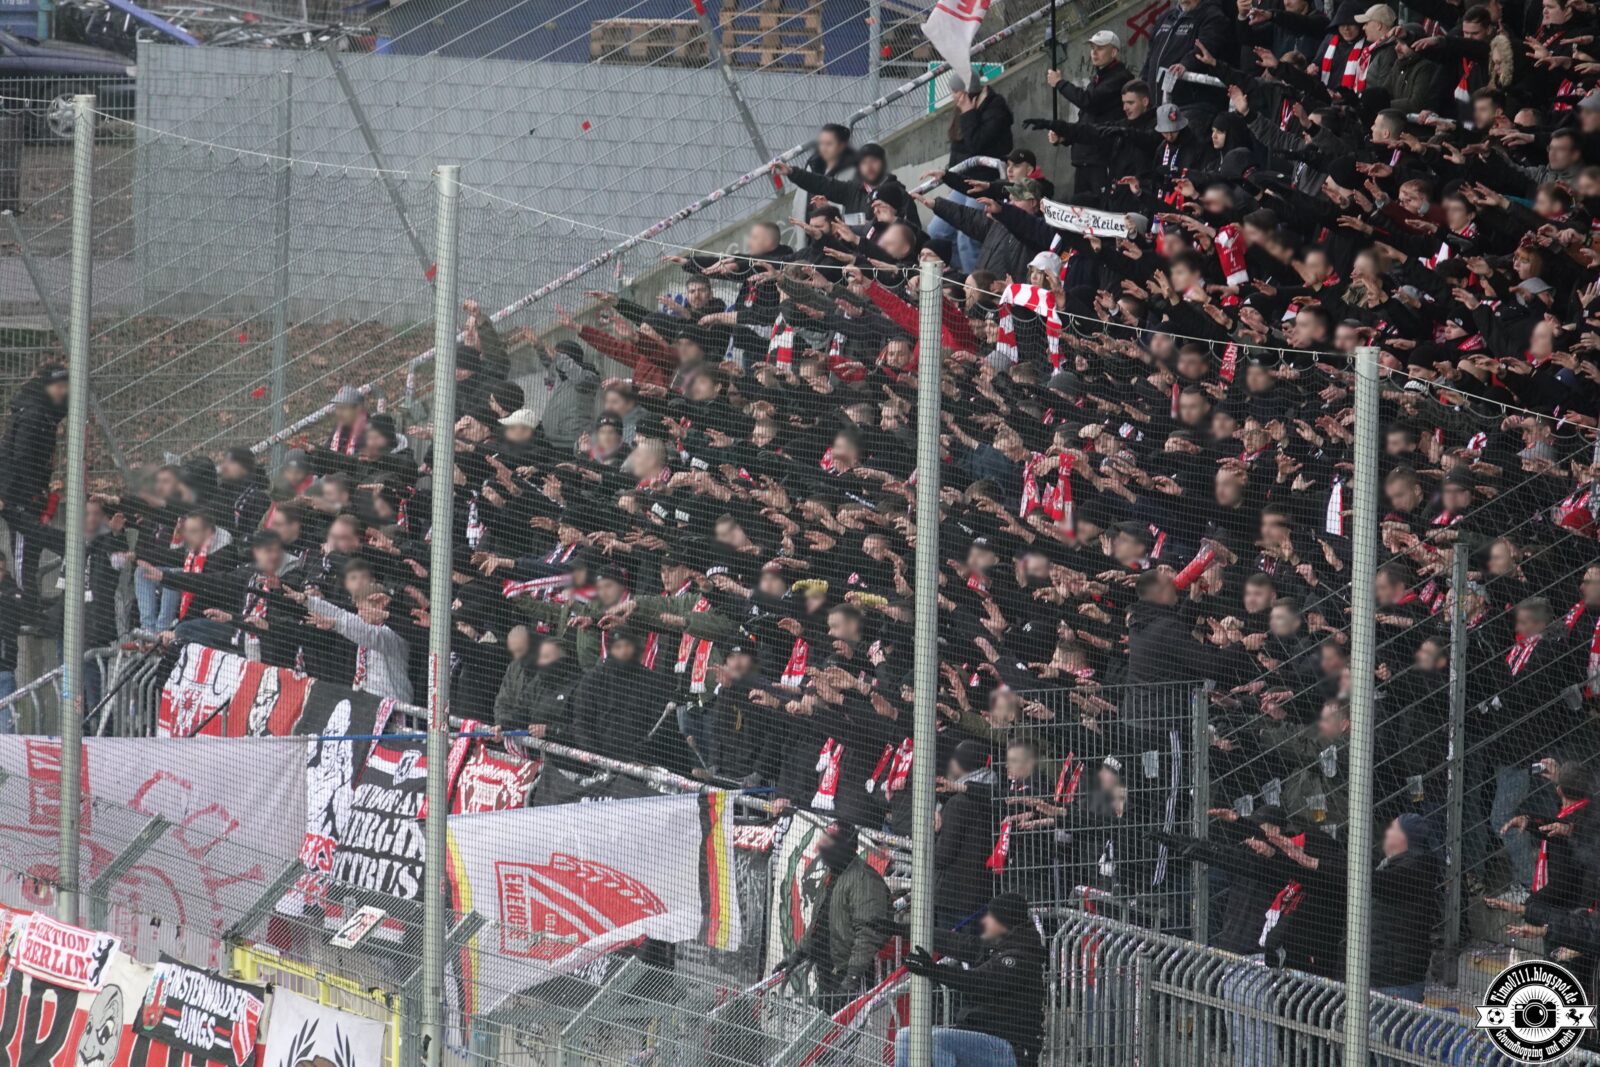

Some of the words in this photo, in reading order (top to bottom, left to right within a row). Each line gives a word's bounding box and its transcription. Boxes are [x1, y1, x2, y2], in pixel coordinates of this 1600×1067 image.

[22, 939, 93, 980] BERLIN
[164, 963, 249, 1022] FINSTERWALDER
[174, 1004, 216, 1051] JUNGS
